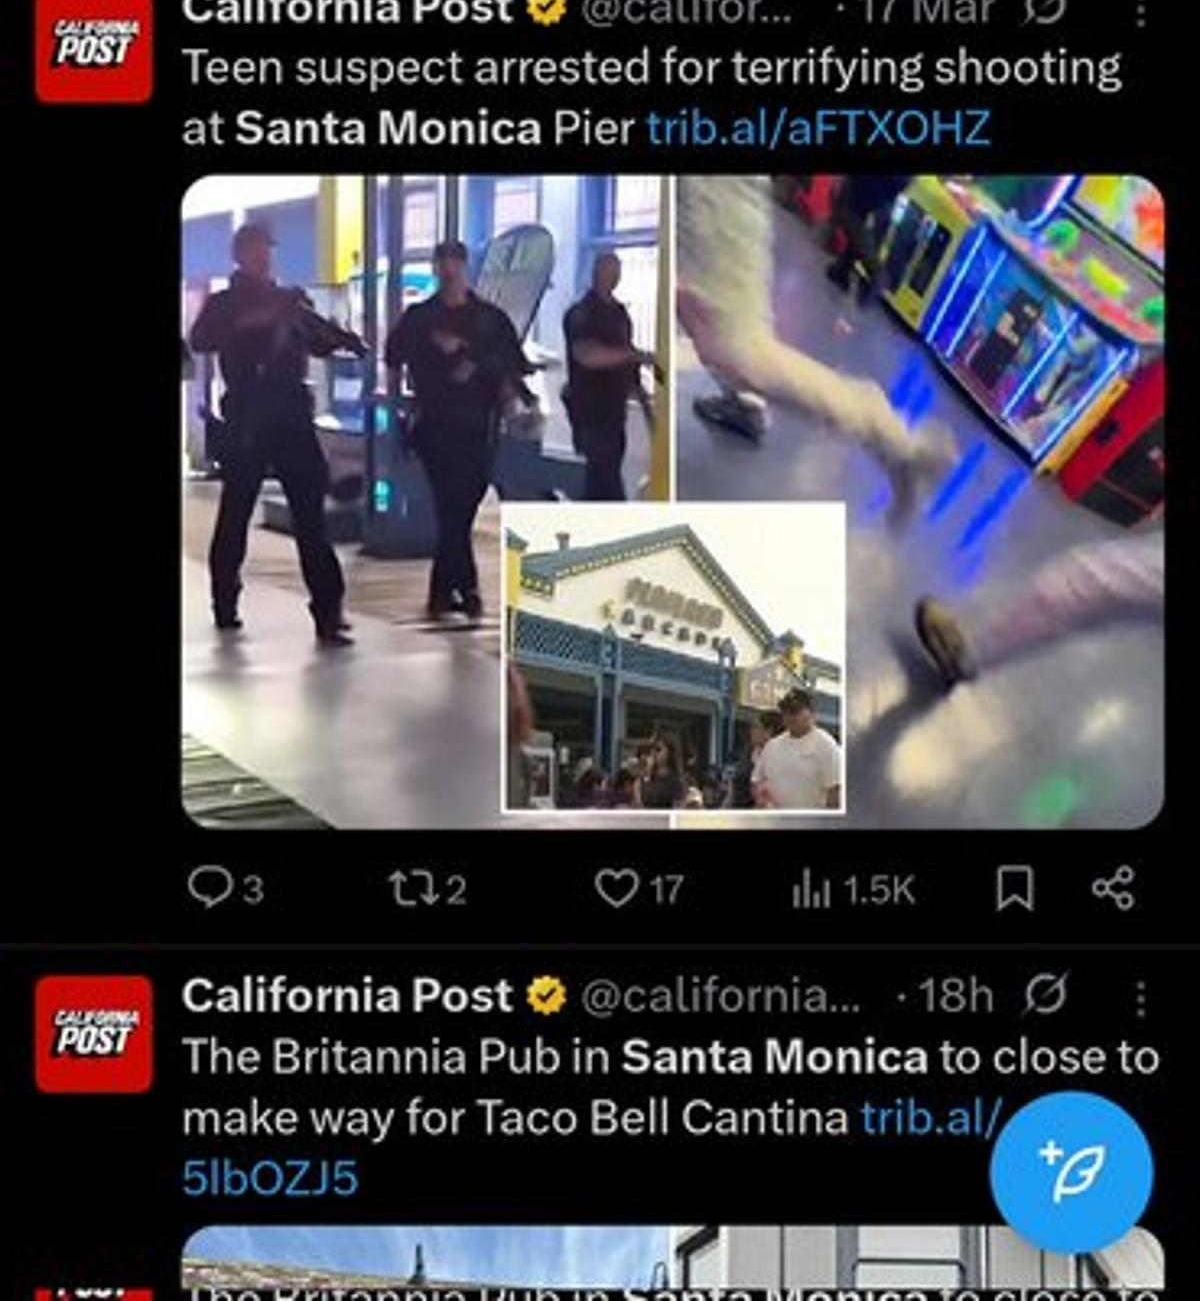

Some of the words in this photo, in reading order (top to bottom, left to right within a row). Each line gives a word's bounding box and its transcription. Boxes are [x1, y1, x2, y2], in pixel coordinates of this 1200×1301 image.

[57, 35, 134, 64] POST
[181, 48, 283, 85] Teen
[295, 51, 463, 93] suspect
[474, 46, 649, 85] arrested
[661, 45, 722, 85] for
[731, 45, 925, 93] terrifying
[935, 46, 1123, 93] shooting
[182, 111, 225, 145] at
[235, 109, 366, 145] Santa
[379, 107, 542, 145] Monica
[555, 108, 636, 145] Pier
[647, 107, 990, 150] trib.al/aFTXOHZ
[243, 874, 265, 904] 3
[447, 874, 466, 905] 2
[650, 874, 684, 904] 17
[844, 874, 915, 905] 1.5K
[182, 974, 401, 1013] California
[413, 977, 514, 1013] Post
[919, 975, 993, 1013] 18h
[57, 1026, 134, 1055] POST
[181, 1036, 261, 1074] The
[273, 1036, 466, 1074] Britannia
[480, 1036, 561, 1074] Pub
[573, 1036, 609, 1074] in
[622, 1037, 753, 1074] Santa
[765, 1036, 928, 1074] Monica
[939, 1040, 981, 1075] to
[993, 1036, 1107, 1074] close
[1117, 1040, 1160, 1074] to
[183, 1097, 299, 1136] make
[309, 1107, 395, 1144] way
[405, 1096, 466, 1136] for
[476, 1098, 578, 1136] Taco
[591, 1096, 668, 1136] Bell
[682, 1098, 848, 1136] Cantina
[861, 1096, 1003, 1140] trib.al/
